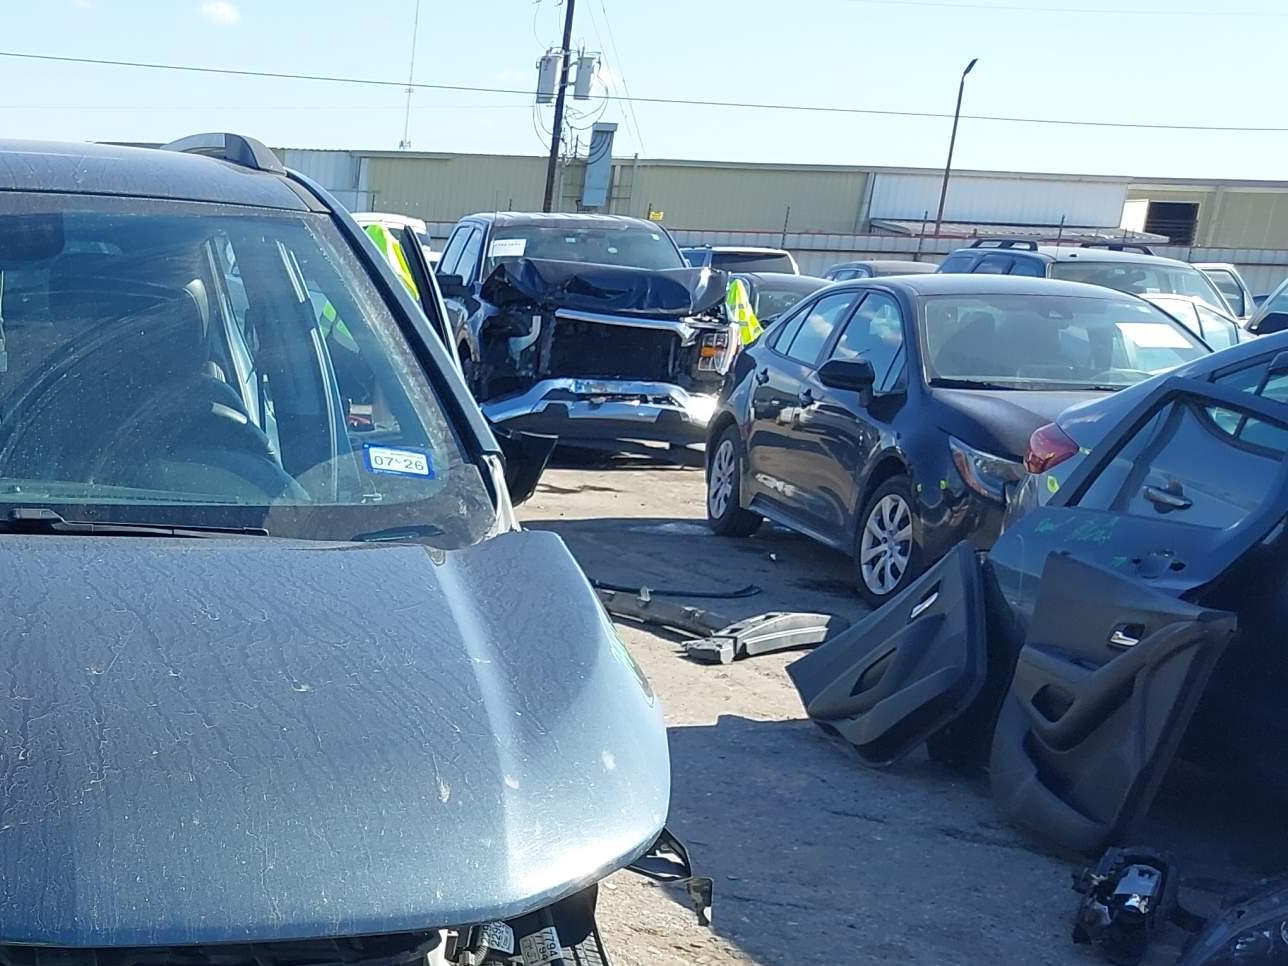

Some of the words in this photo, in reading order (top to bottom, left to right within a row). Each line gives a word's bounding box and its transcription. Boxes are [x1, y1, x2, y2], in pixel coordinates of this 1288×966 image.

[374, 455, 394, 467] 07
[403, 458, 424, 471] 26
[542, 927, 559, 956] 7794
